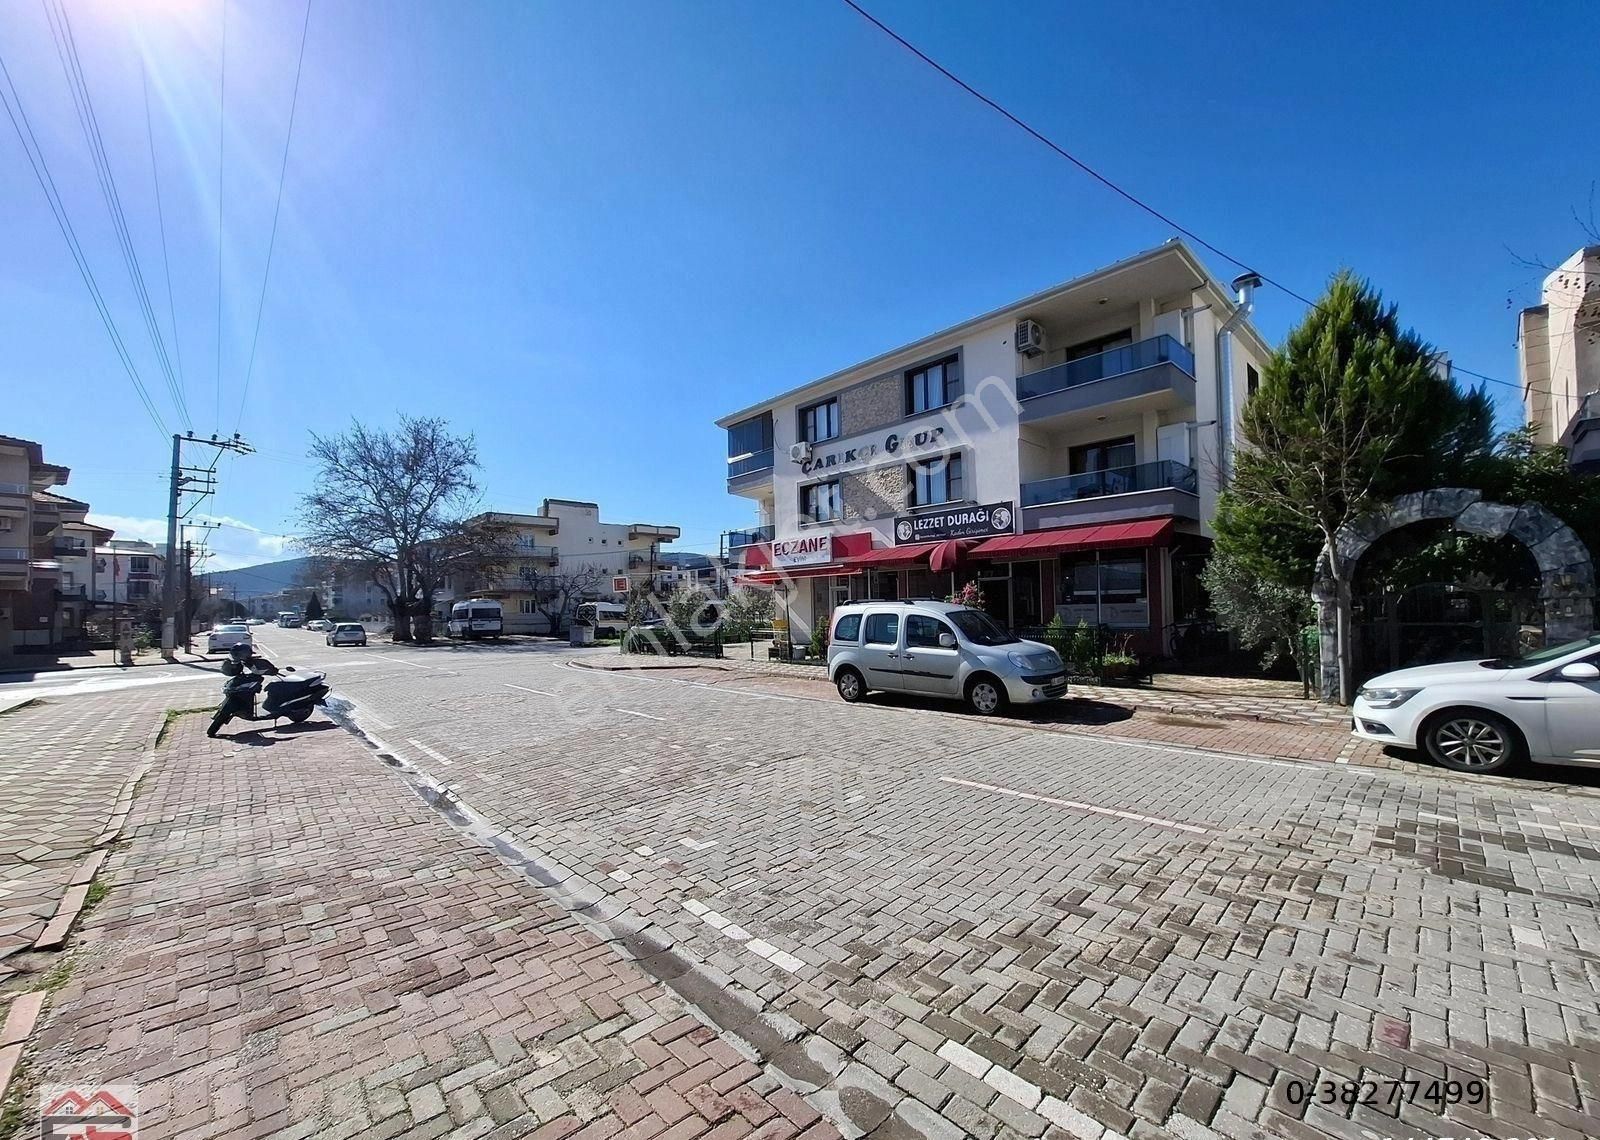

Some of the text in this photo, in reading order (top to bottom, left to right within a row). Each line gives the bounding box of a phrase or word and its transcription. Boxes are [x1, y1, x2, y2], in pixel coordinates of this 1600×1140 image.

[913, 508, 989, 530] LEZZET DURAĞI
[774, 536, 828, 556] ECZANE
